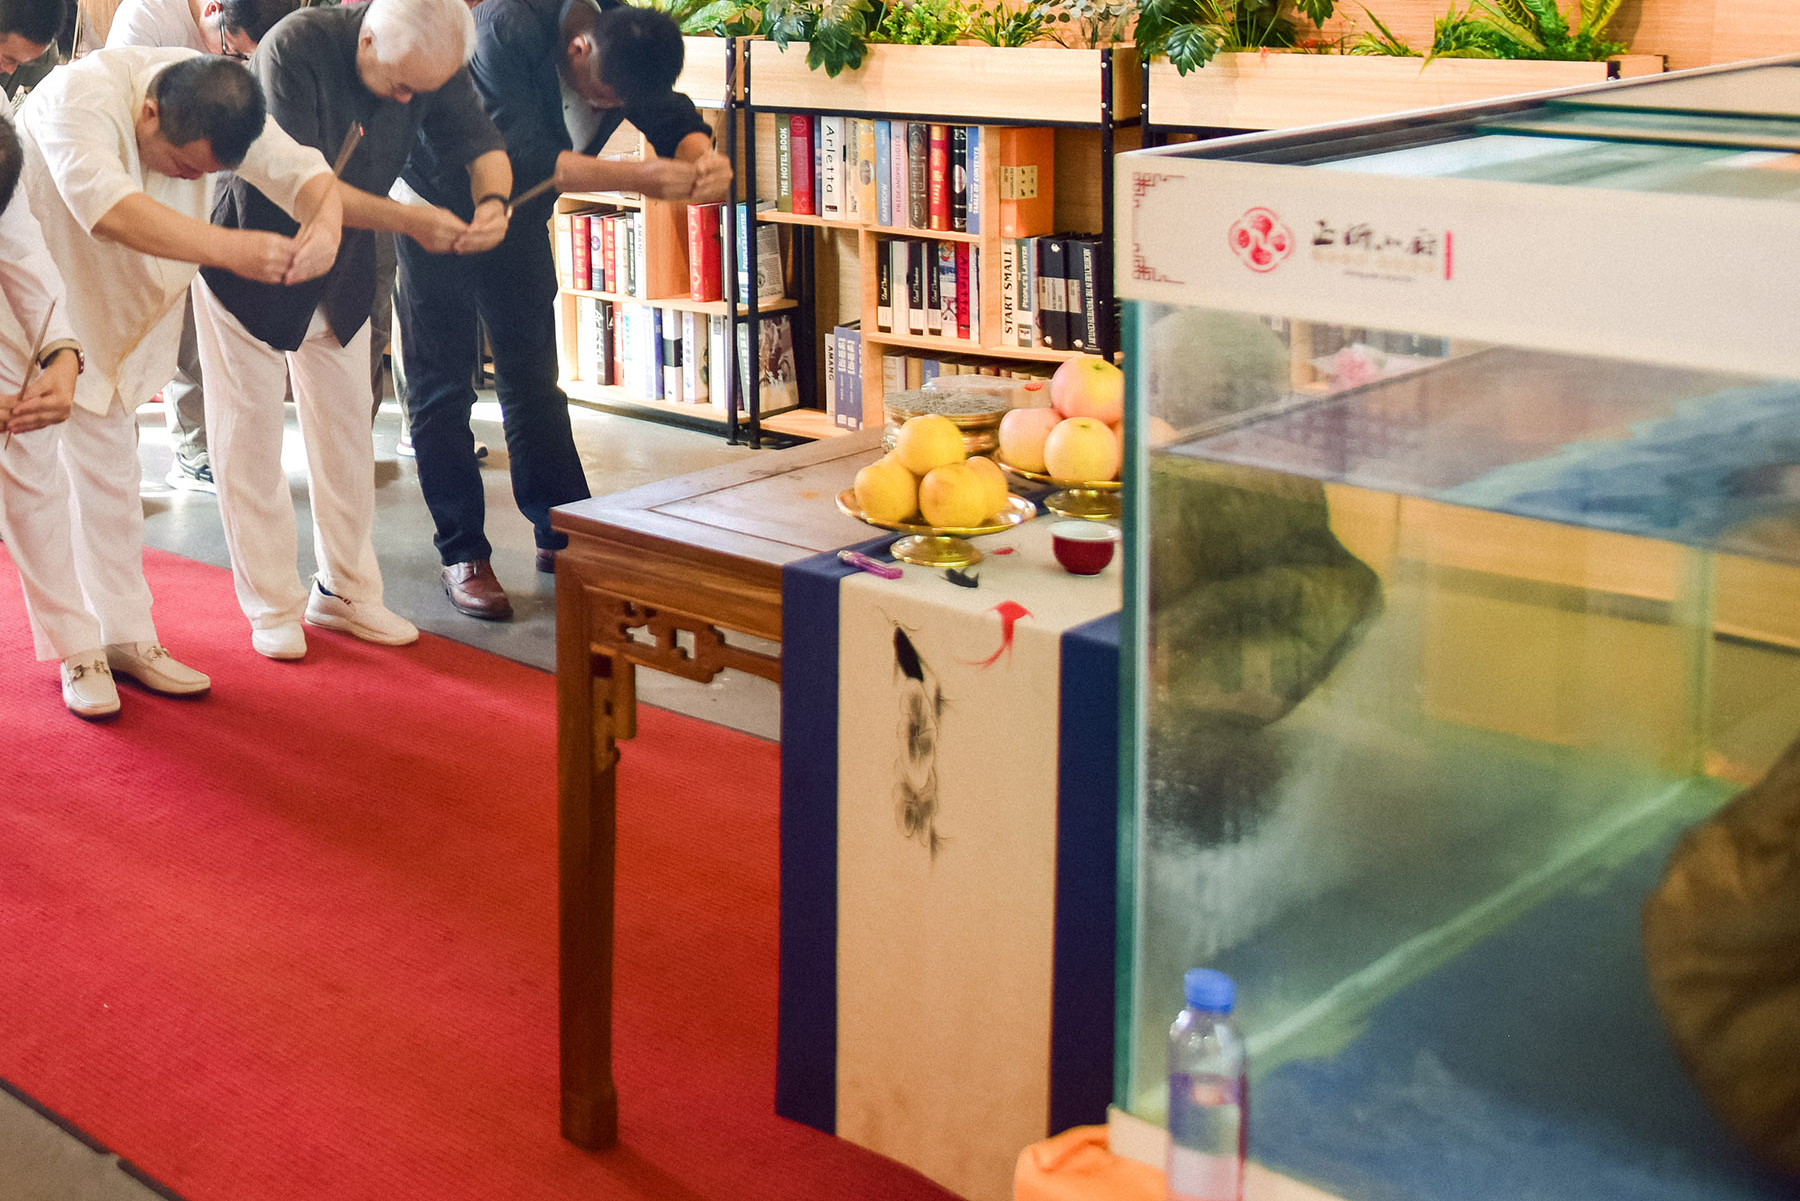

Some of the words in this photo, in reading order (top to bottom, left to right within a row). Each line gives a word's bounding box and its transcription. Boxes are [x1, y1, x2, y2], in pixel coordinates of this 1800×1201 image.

[779, 127, 788, 151] BOOK
[851, 119, 859, 149] American
[780, 152, 788, 179] HOTEL
[825, 124, 836, 193] Arletta
[851, 151, 859, 167] Style
[781, 180, 789, 197] THE
[1003, 248, 1013, 291] SMALL
[1021, 245, 1029, 274] LAWYER
[1083, 248, 1093, 282] ARCHITECTURE
[960, 256, 969, 314] Arletta
[1021, 276, 1029, 308] PEOPLE'S
[1004, 294, 1013, 334] START
[827, 345, 835, 381] AMANG
